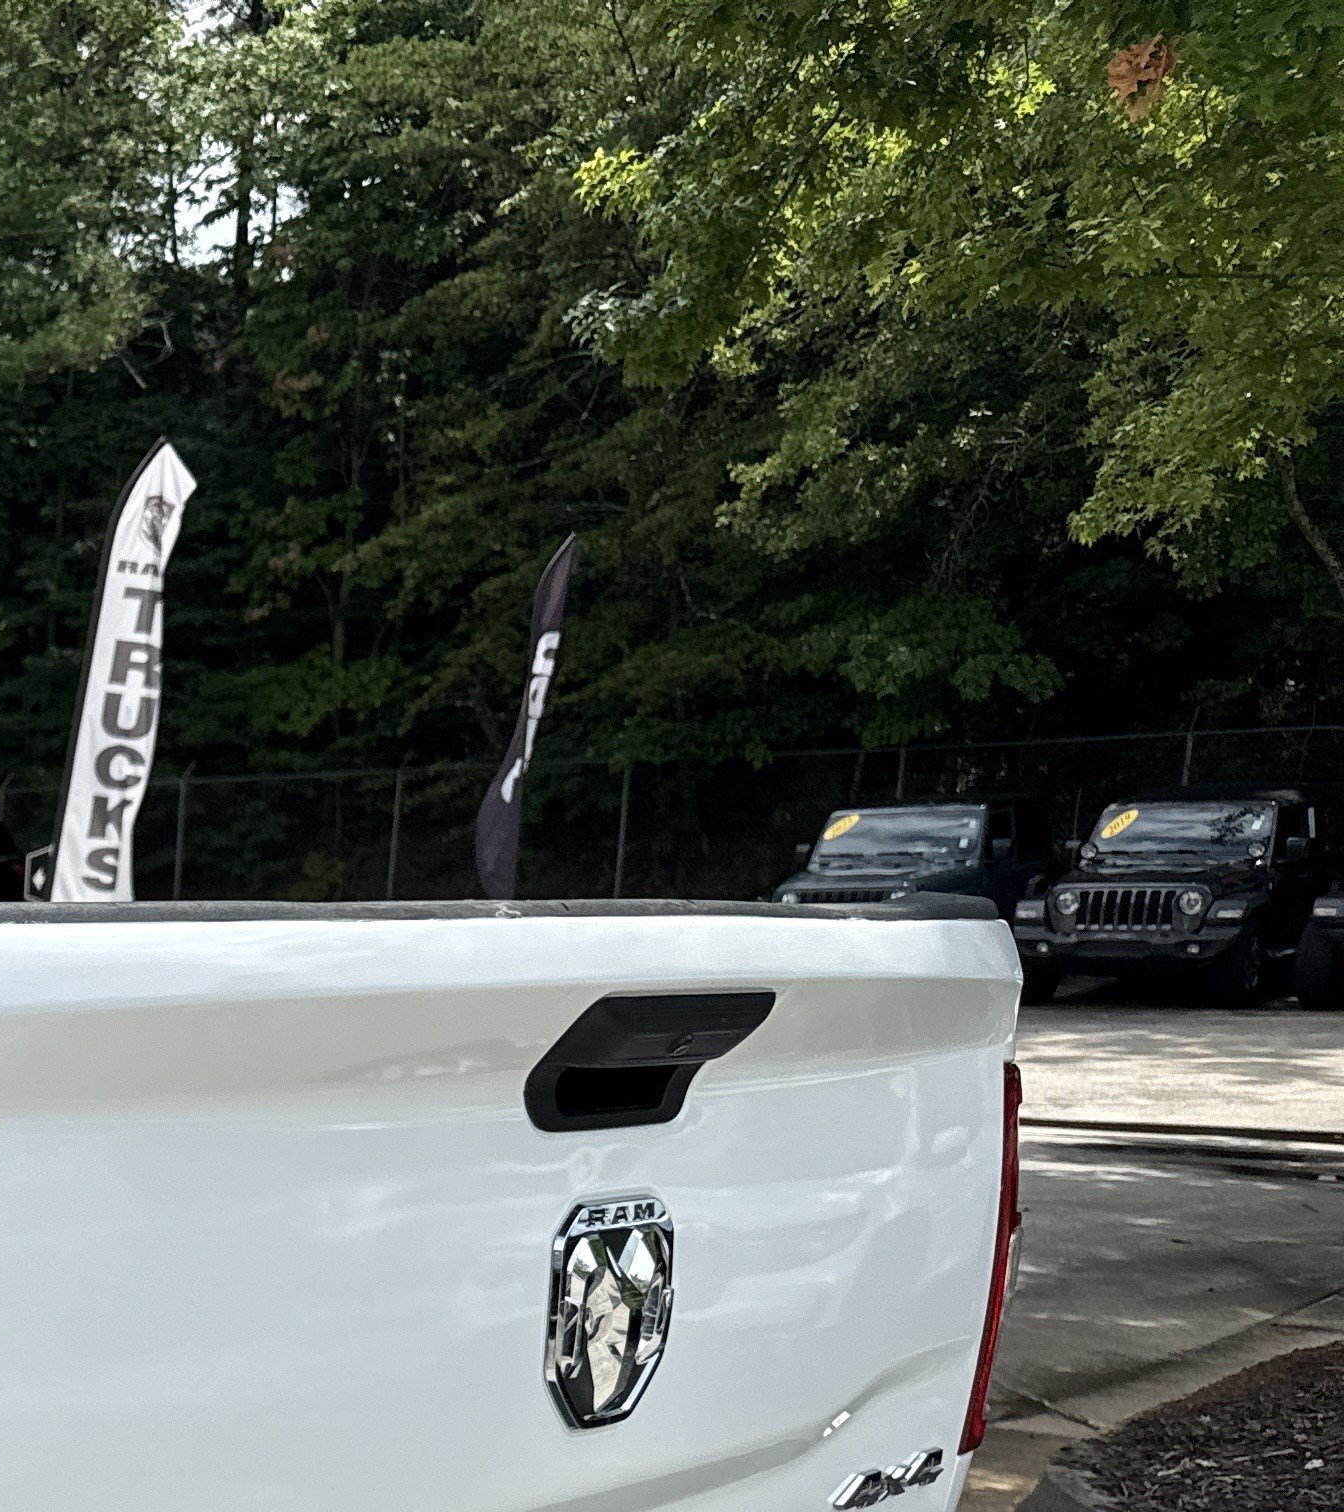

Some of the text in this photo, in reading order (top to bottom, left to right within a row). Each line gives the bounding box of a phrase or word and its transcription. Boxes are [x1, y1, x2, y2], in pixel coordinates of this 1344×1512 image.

[116, 560, 160, 577] RA
[82, 586, 163, 893] TRUCKS
[584, 1201, 655, 1228] RAM
